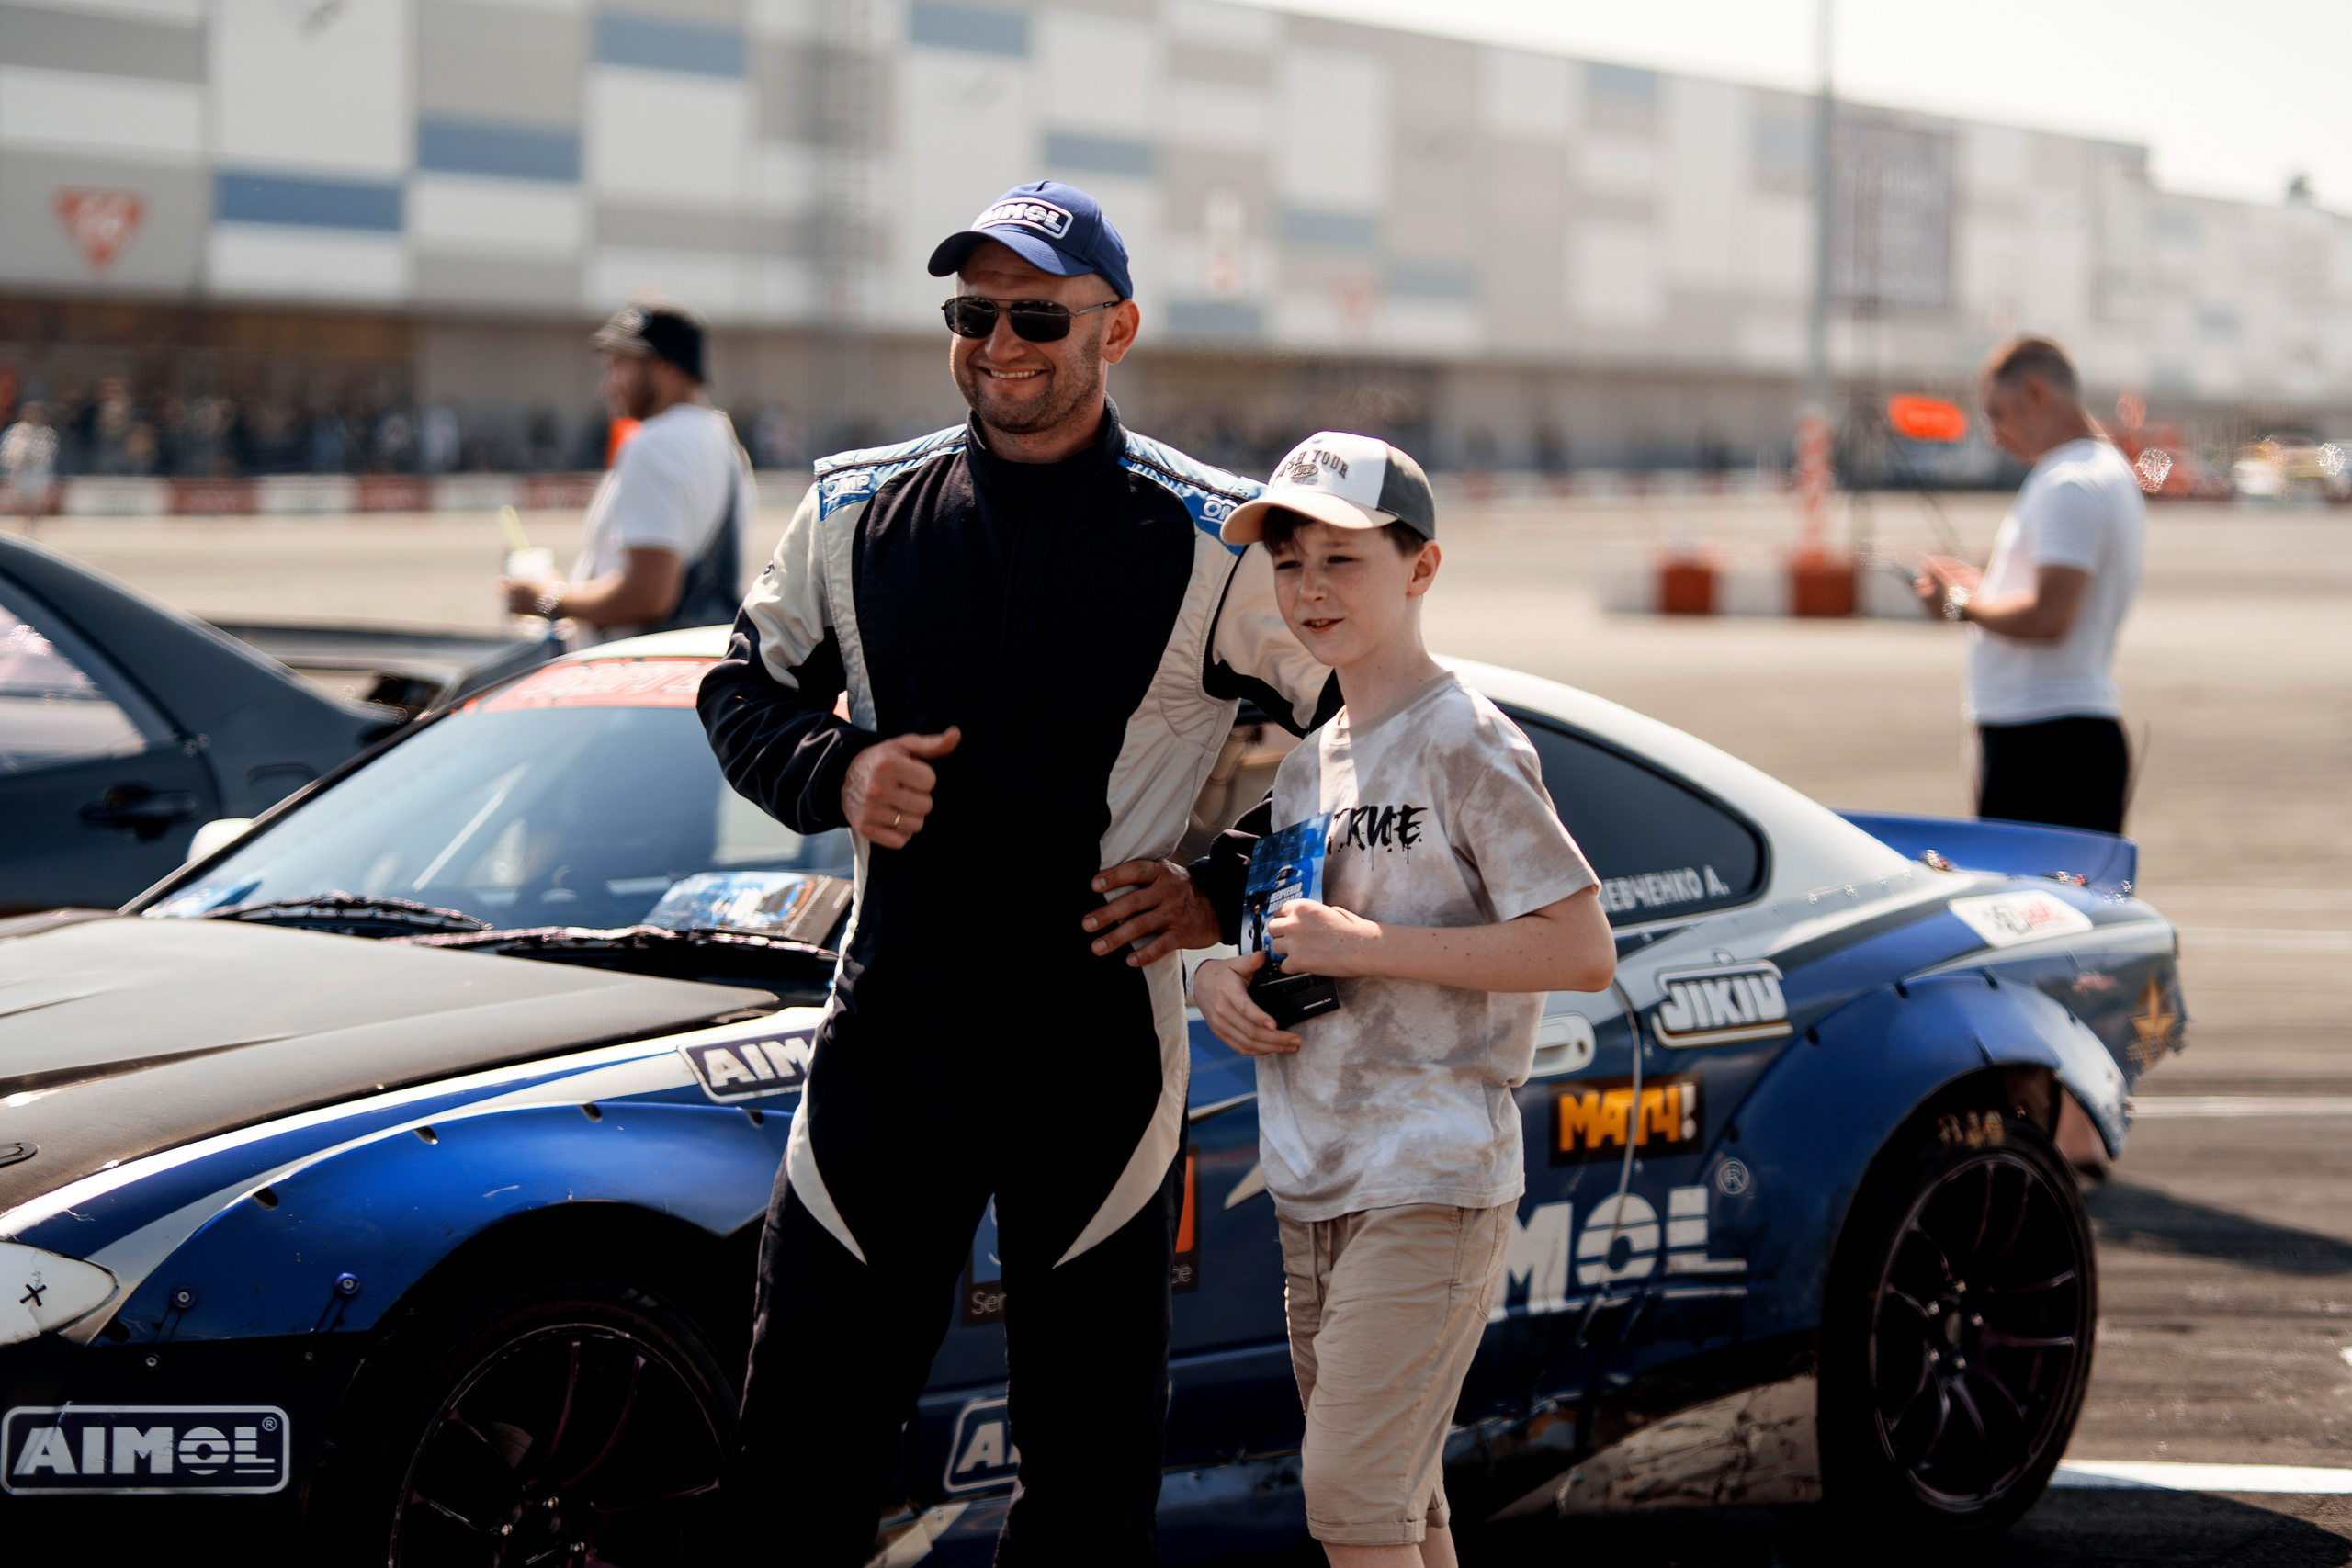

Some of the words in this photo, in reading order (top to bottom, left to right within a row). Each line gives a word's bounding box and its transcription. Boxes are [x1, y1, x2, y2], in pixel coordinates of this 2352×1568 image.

[1311, 448, 1349, 479] YOUR
[822, 474, 870, 497] OMP
[703, 1037, 811, 1088] AIM
[1487, 1184, 1748, 1324] MOL
